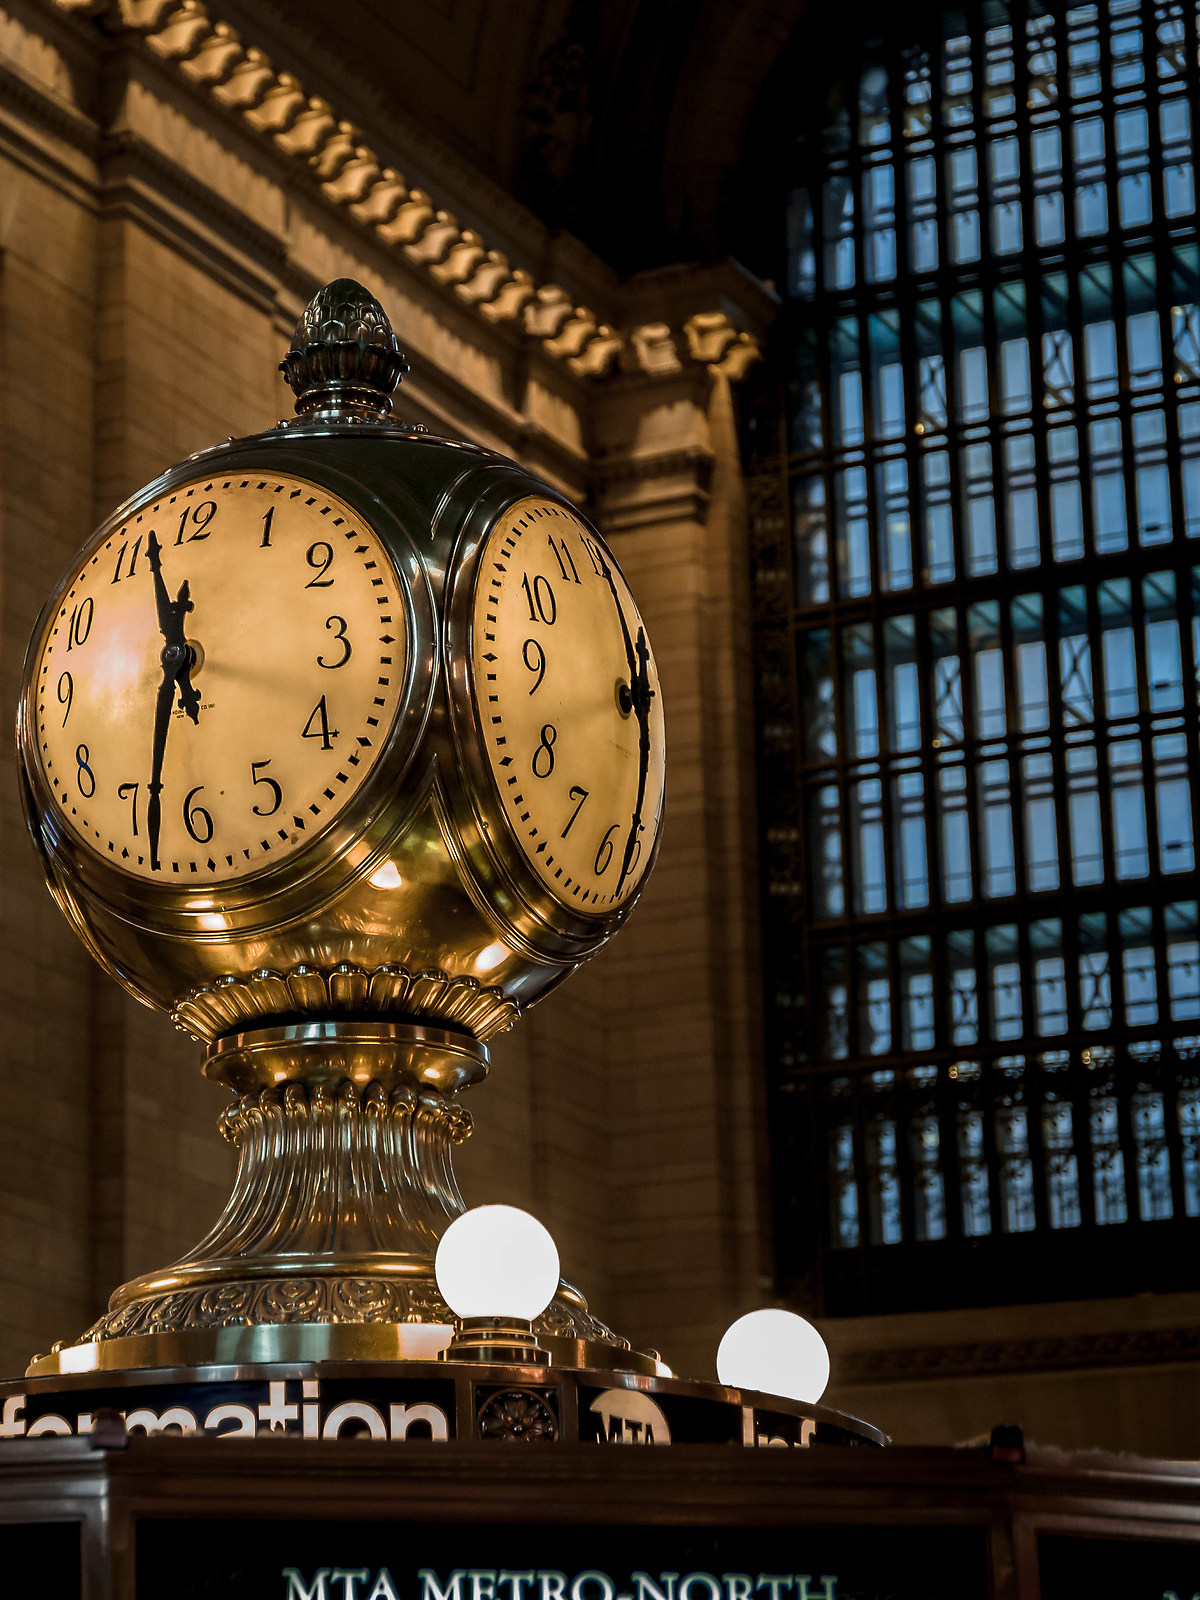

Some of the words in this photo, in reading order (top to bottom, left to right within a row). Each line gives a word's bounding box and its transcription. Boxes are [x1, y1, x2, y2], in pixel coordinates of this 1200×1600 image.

[173, 501, 217, 546] 12
[260, 506, 274, 547] 1
[111, 534, 142, 584] 11
[305, 542, 334, 588] 2
[547, 533, 582, 585] 11
[66, 597, 93, 652] 10
[522, 572, 556, 625] 10
[317, 616, 351, 669] 3
[523, 639, 545, 695] 9
[58, 672, 73, 727] 9
[302, 695, 340, 750] 4
[76, 744, 95, 798] 8
[532, 724, 557, 778] 8
[118, 783, 139, 836] 7
[252, 759, 282, 816] 5
[561, 786, 589, 838] 7
[183, 786, 213, 843] 6
[594, 824, 620, 876] 6
